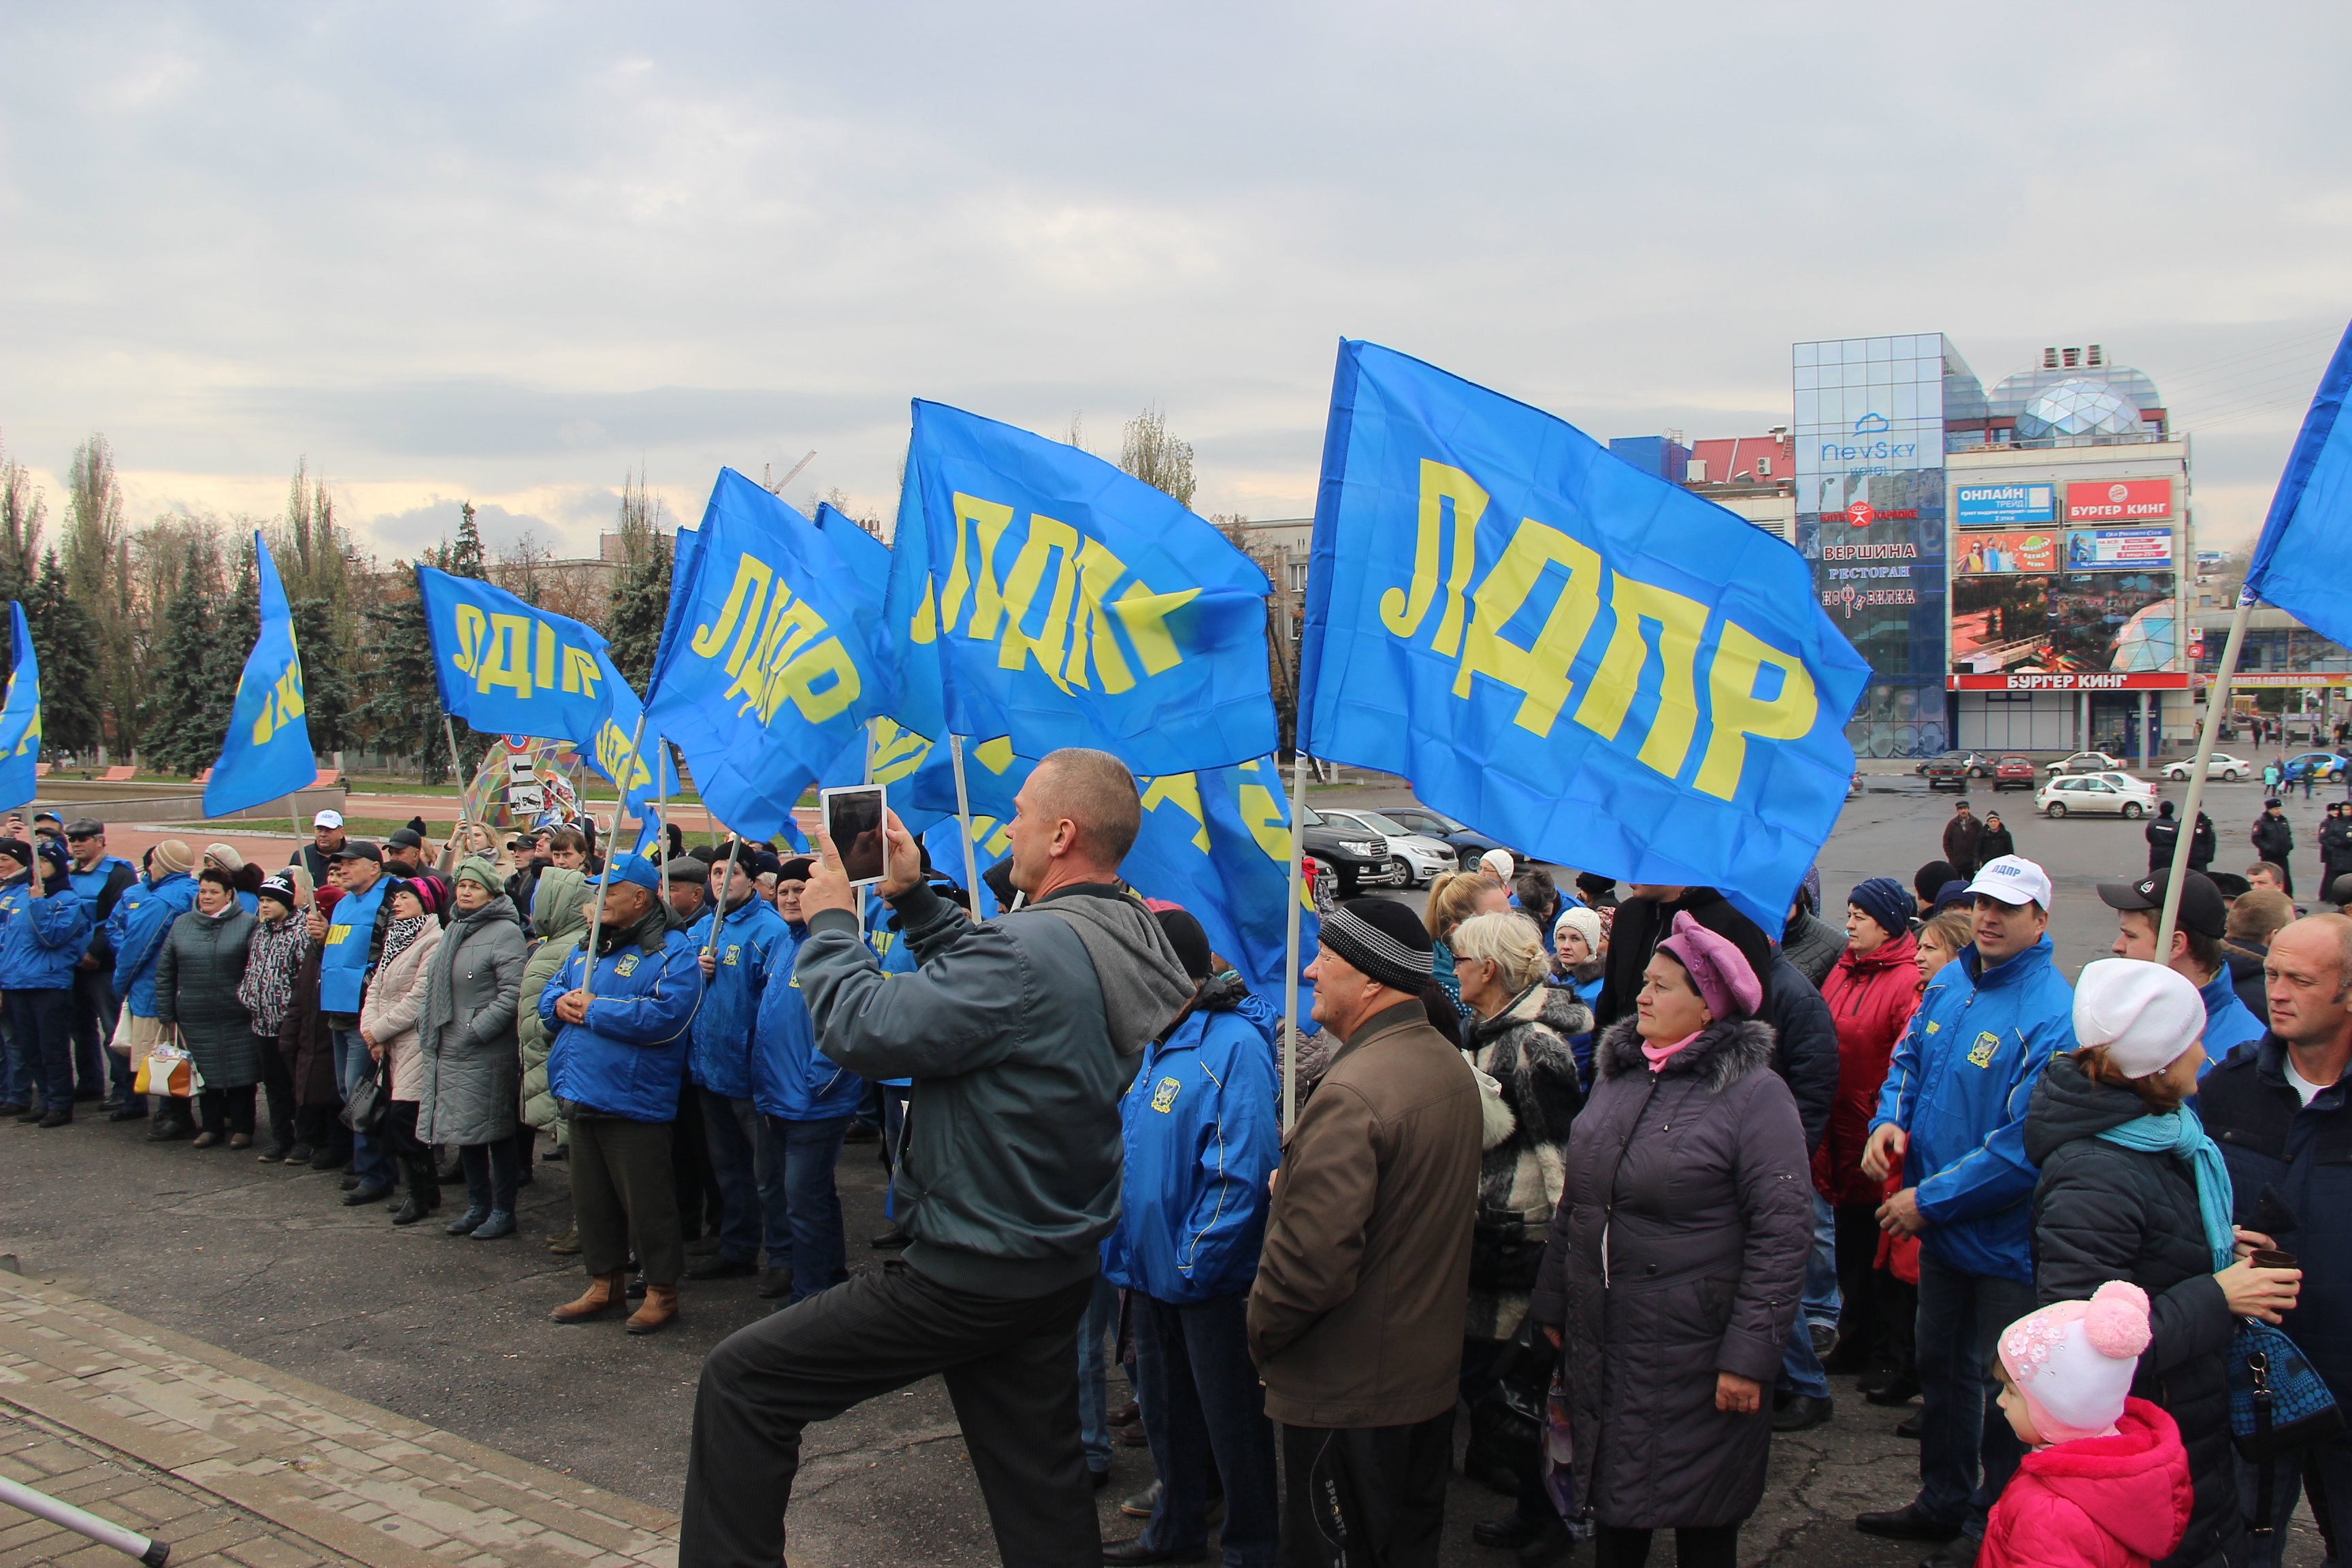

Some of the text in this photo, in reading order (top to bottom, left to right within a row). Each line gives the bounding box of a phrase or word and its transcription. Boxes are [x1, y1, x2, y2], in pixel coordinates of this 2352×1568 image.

[1961, 486, 2023, 501] ОНЛАЙН
[1995, 499, 2024, 508] ТРЕЙД
[2071, 503, 2166, 517] БУРГЕР КИНГ
[1823, 543, 1917, 561] ВЕРШИНА
[1829, 566, 1911, 580] РЕСТОРАН
[1379, 458, 1818, 802] ЛДПР
[2007, 674, 2128, 689] БУРГЕР КИНГ
[1991, 864, 2021, 877] ЛДПР
[1325, 1480, 1347, 1536] SPORTS
